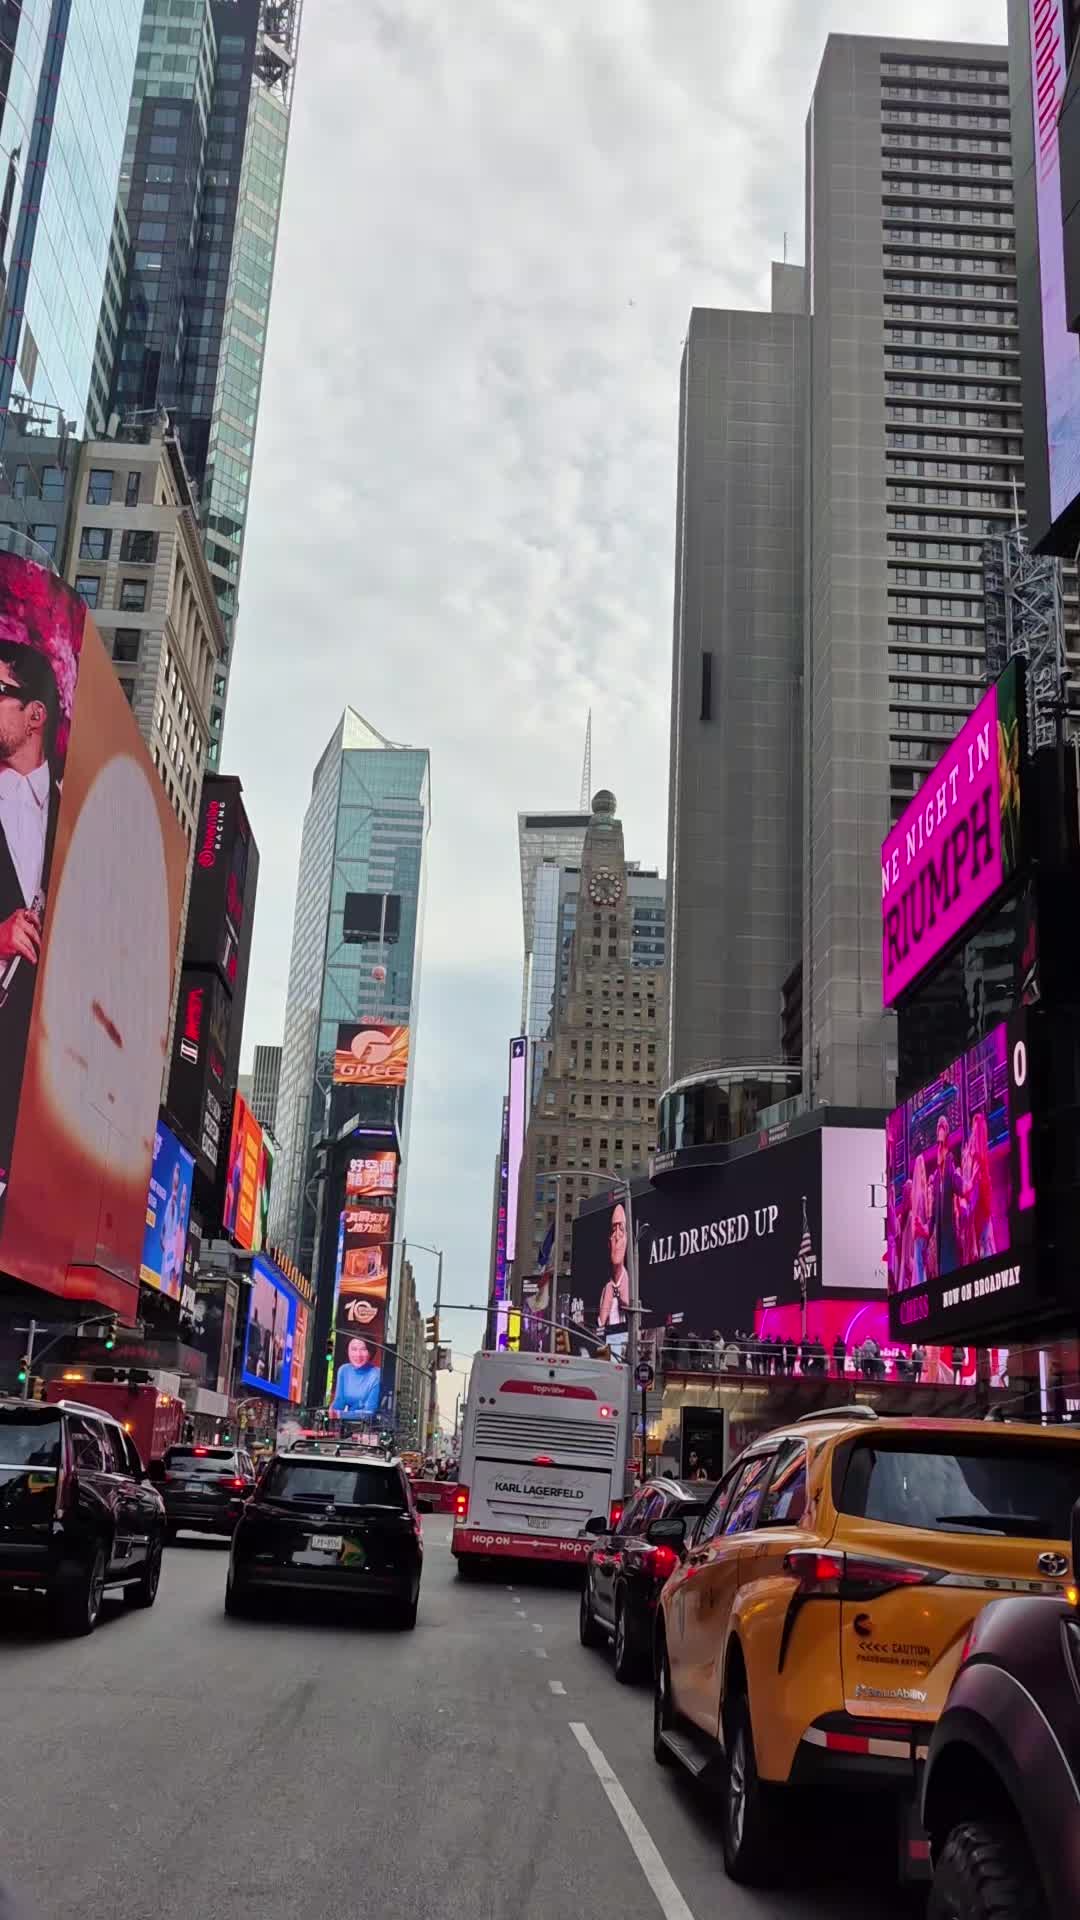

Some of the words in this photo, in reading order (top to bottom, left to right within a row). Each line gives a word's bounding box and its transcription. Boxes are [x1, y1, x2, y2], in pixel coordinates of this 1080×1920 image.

[906, 764, 959, 866] NIGHT
[968, 722, 991, 784] IN
[214, 802, 226, 850] RACING
[883, 786, 993, 976] RIUMPH
[649, 1235, 676, 1265] ALL
[679, 1213, 749, 1257] DRESSED
[754, 1204, 779, 1236] UP
[942, 1290, 960, 1308] NOW
[961, 1284, 972, 1301] ON
[973, 1265, 1021, 1298] BROADWAY
[495, 1481, 521, 1494] KARL
[523, 1484, 584, 1500] LAGERFELD
